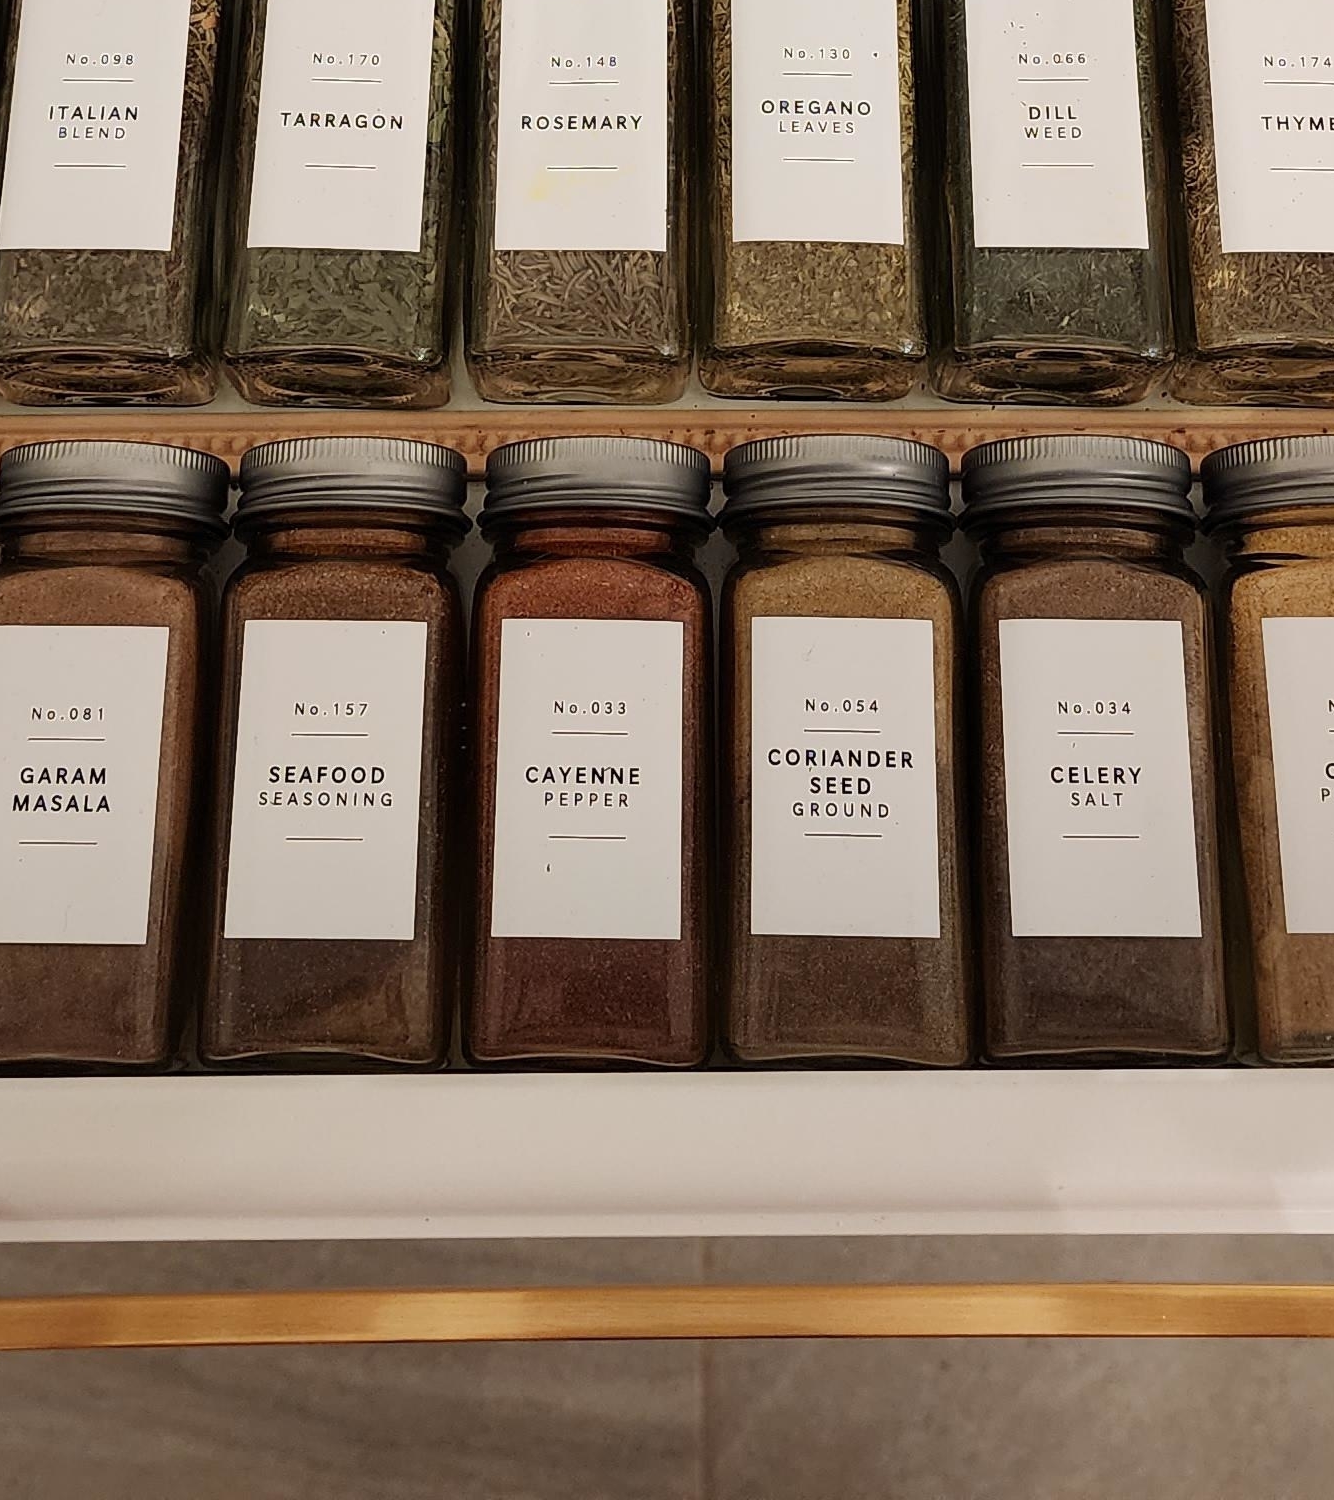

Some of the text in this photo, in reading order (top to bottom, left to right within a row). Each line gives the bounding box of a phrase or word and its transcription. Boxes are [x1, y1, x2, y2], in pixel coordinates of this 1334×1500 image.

[66, 53, 134, 66] No.098
[312, 52, 380, 66] No.170
[784, 47, 850, 60] No.130
[1018, 53, 1086, 65] No.066
[551, 56, 617, 68] No.148
[1263, 55, 1332, 68] No.174
[49, 105, 138, 121] ITALIAN
[761, 99, 871, 116] OREGANO
[1028, 105, 1077, 120] DILL
[280, 112, 403, 130] TARRAGON
[521, 115, 643, 130] ROSEMARY
[779, 120, 854, 134] LEAVES
[58, 126, 126, 140] BLEND
[1024, 126, 1082, 139] WEED
[294, 702, 368, 716] No.157
[553, 700, 626, 715] No.033
[805, 698, 879, 714] No.054
[1057, 701, 1132, 715] No.034
[31, 707, 103, 721] No.081
[767, 748, 914, 769] CORIANDER
[20, 767, 106, 785] GARAM
[268, 765, 385, 784] SEAFOOD
[525, 766, 640, 785] CAYENNE
[1050, 766, 1142, 785] CELERY
[809, 776, 871, 795] SEED
[12, 794, 111, 813] MASALA
[258, 791, 392, 807] SEASONING
[544, 791, 629, 808] PEPPER
[1070, 792, 1124, 807] SALT
[792, 802, 889, 819] GROUND
